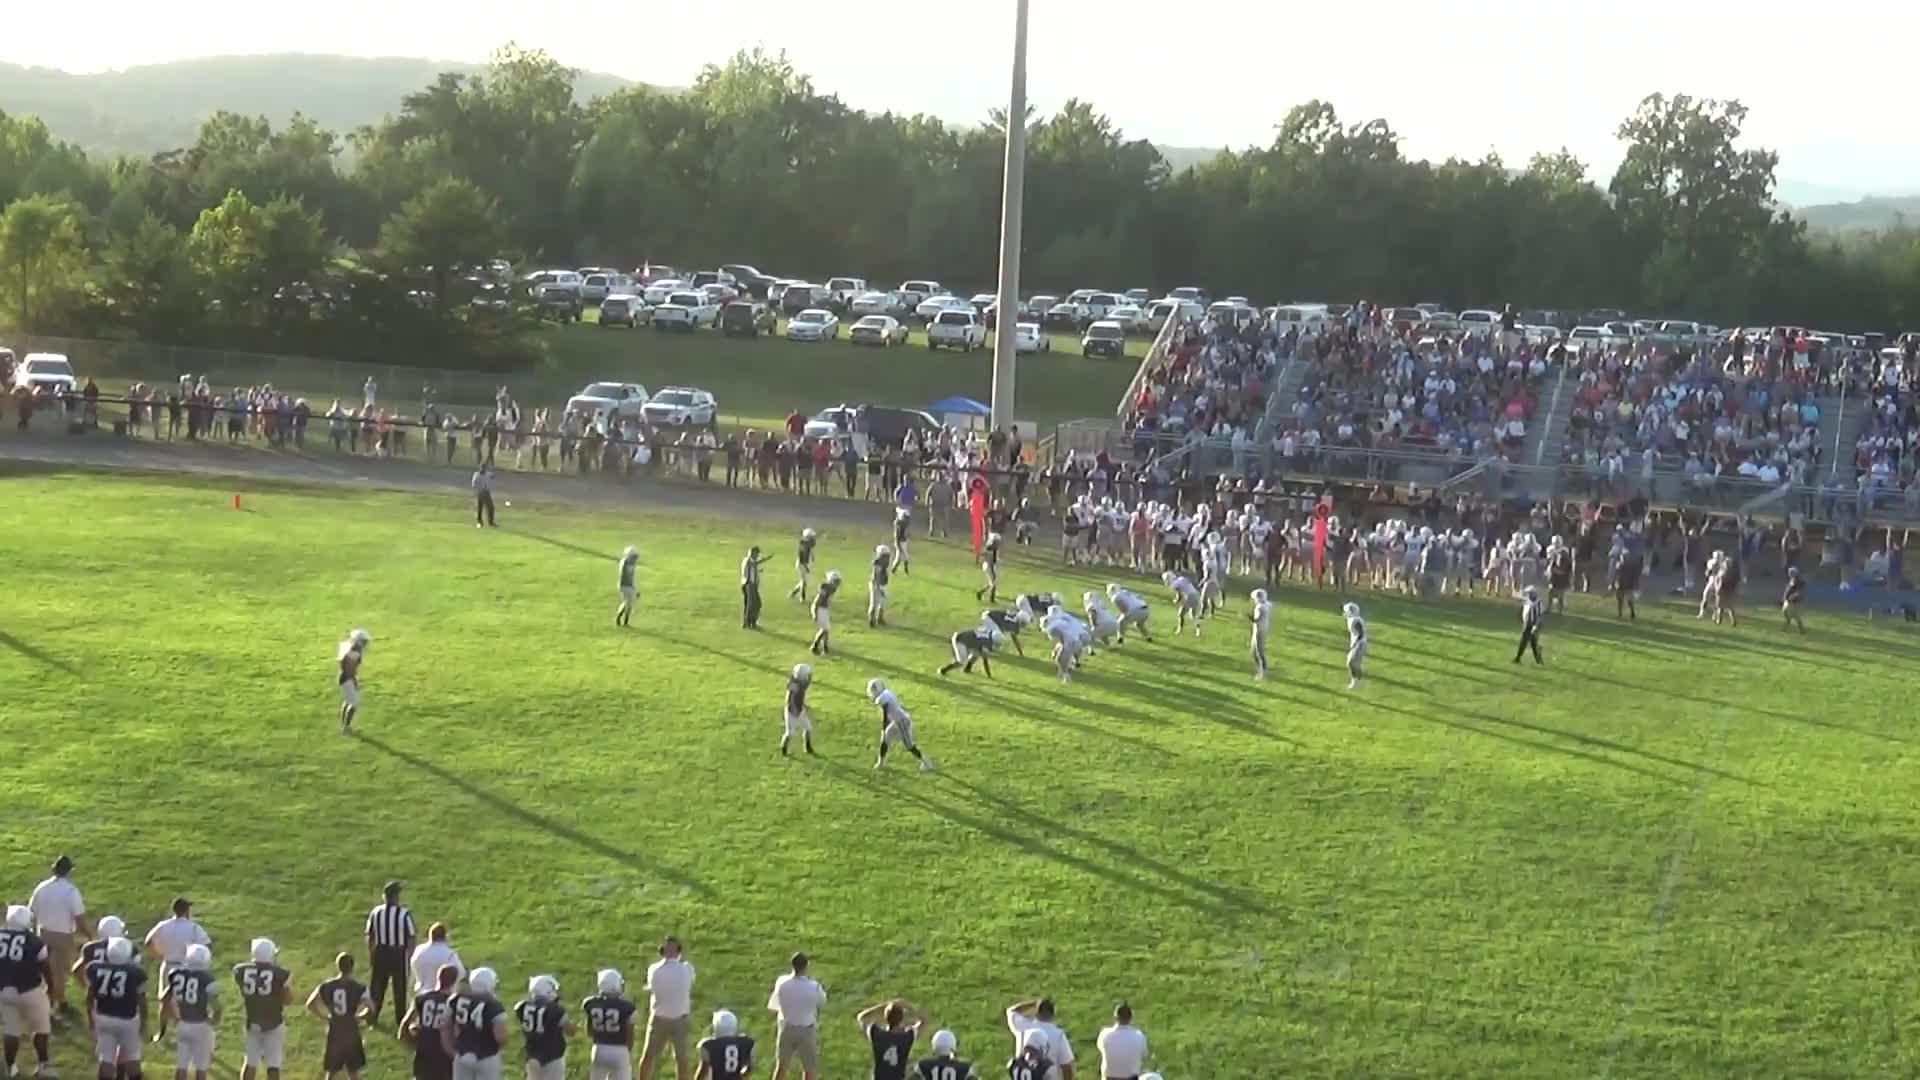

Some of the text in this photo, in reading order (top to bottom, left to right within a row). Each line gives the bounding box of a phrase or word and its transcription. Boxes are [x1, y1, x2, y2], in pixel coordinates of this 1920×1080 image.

[97, 968, 127, 997] 73
[173, 973, 198, 1004] 28
[243, 968, 273, 996] 53
[333, 988, 346, 1015] 9
[422, 999, 448, 1028] 62
[455, 996, 485, 1029] 54
[522, 1005, 546, 1032] 51
[591, 1007, 620, 1033] 22
[725, 1045, 738, 1072] 8
[883, 1045, 898, 1066] 4
